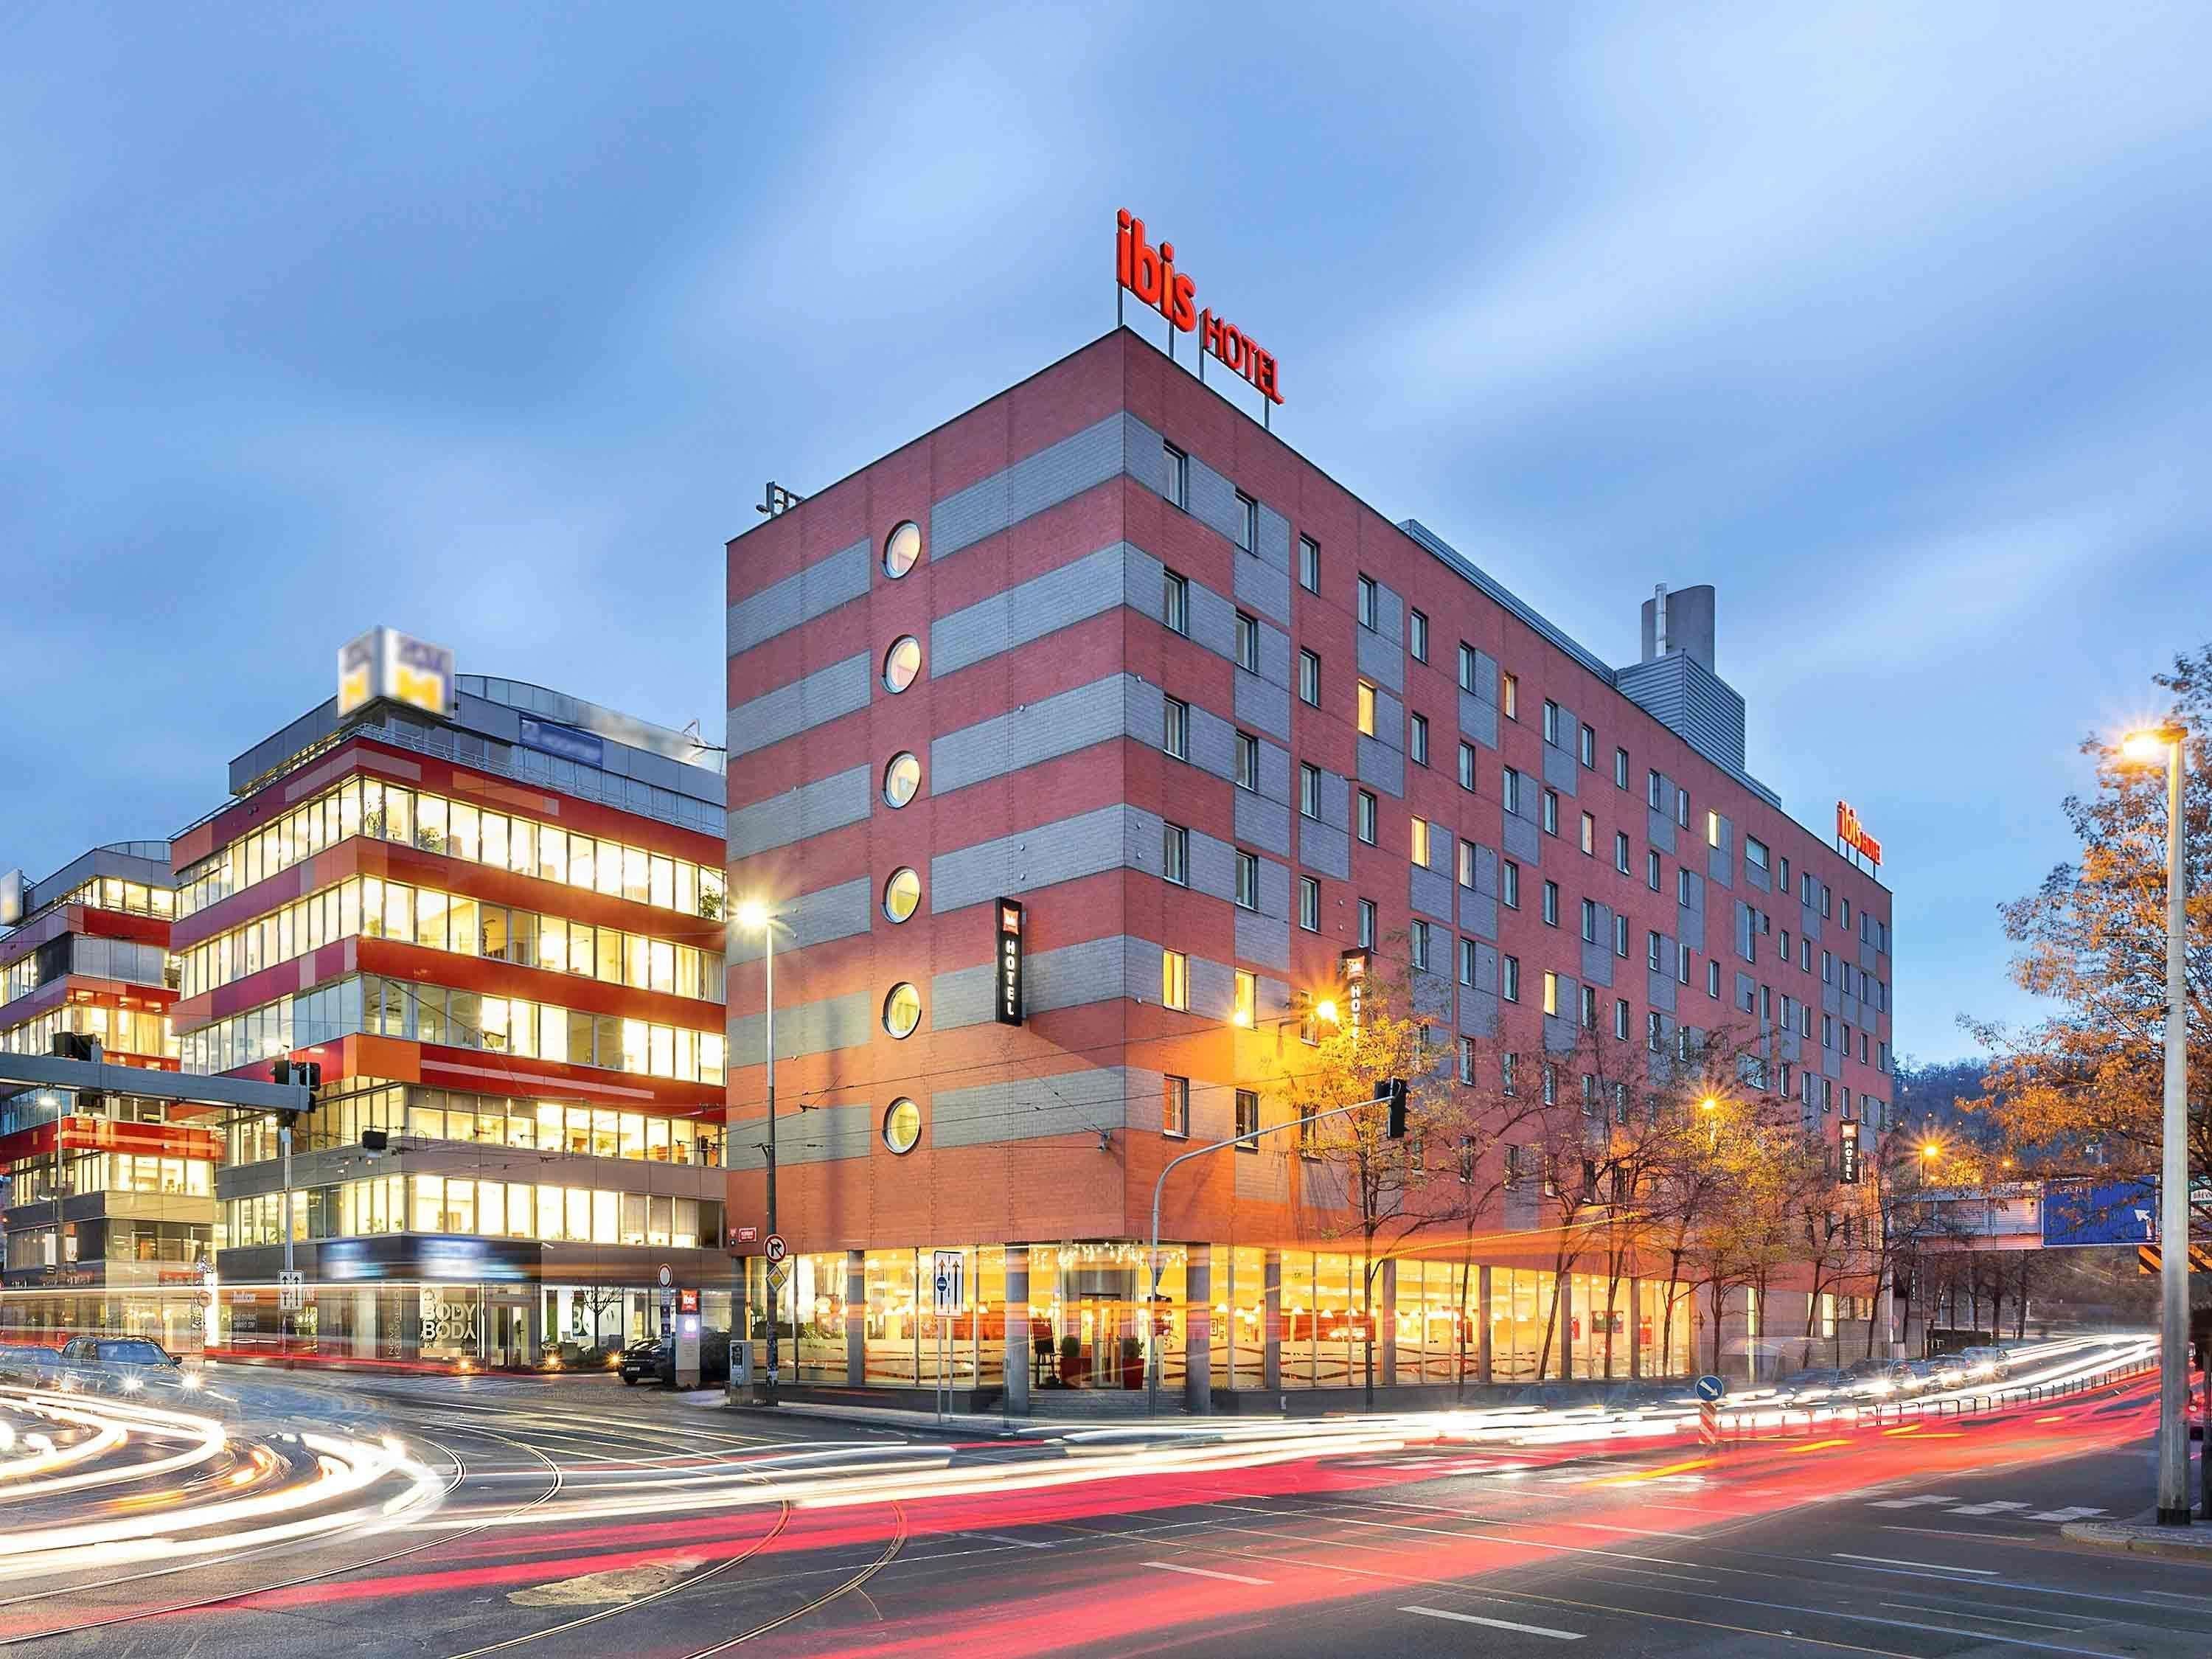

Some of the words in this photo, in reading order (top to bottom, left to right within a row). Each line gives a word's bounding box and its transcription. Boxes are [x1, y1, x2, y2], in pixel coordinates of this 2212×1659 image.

[1116, 207, 1197, 333] ibis
[1199, 307, 1285, 406] HOTEL
[1006, 940, 1015, 1016] HOTEL
[1845, 1140, 1853, 1180] HOTEL
[423, 1303, 477, 1321] BODY
